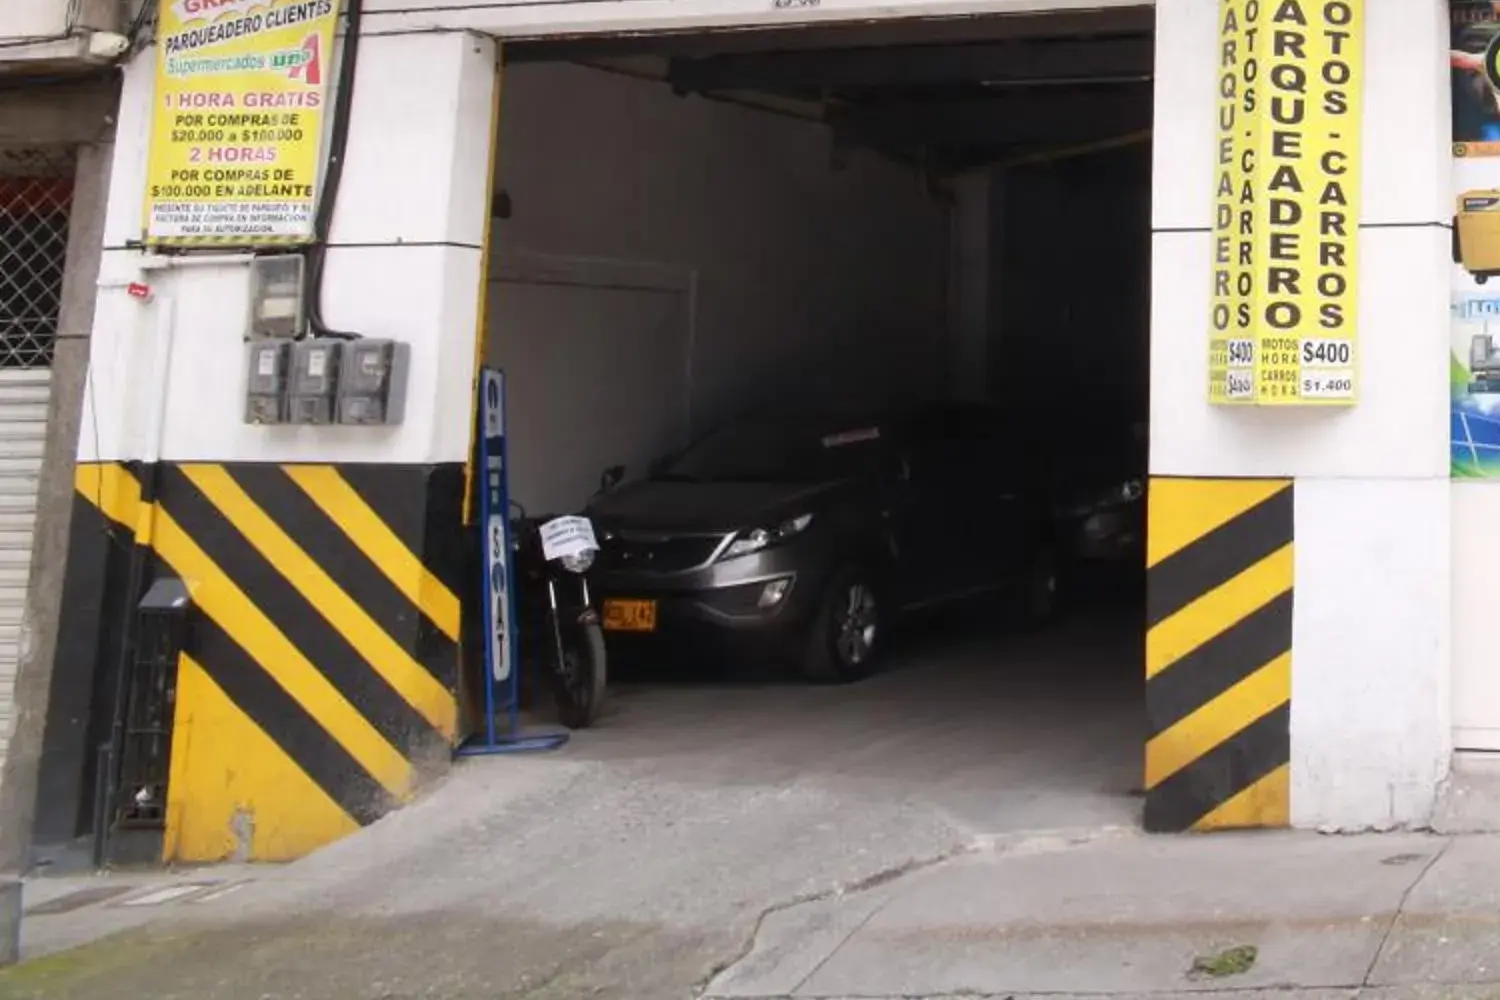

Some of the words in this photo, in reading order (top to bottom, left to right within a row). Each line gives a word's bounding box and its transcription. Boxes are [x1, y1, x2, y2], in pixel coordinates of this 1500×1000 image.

[165, 14, 262, 53] PARQUEADERO
[179, 93, 235, 107] HORA
[243, 91, 321, 107] GRATIS
[175, 114, 203, 126] POR
[207, 114, 278, 126] COMPRAS
[189, 149, 201, 162] 2
[207, 147, 277, 162] HORAS
[171, 169, 199, 181] POR
[203, 169, 269, 181] COMPRAS
[273, 169, 294, 181] DE
[215, 185, 235, 197] EN
[237, 184, 313, 197] ADELANTE
[1261, 339, 1299, 350] MOTOS
[1303, 341, 1350, 363] $400
[1261, 354, 1298, 365] HORA
